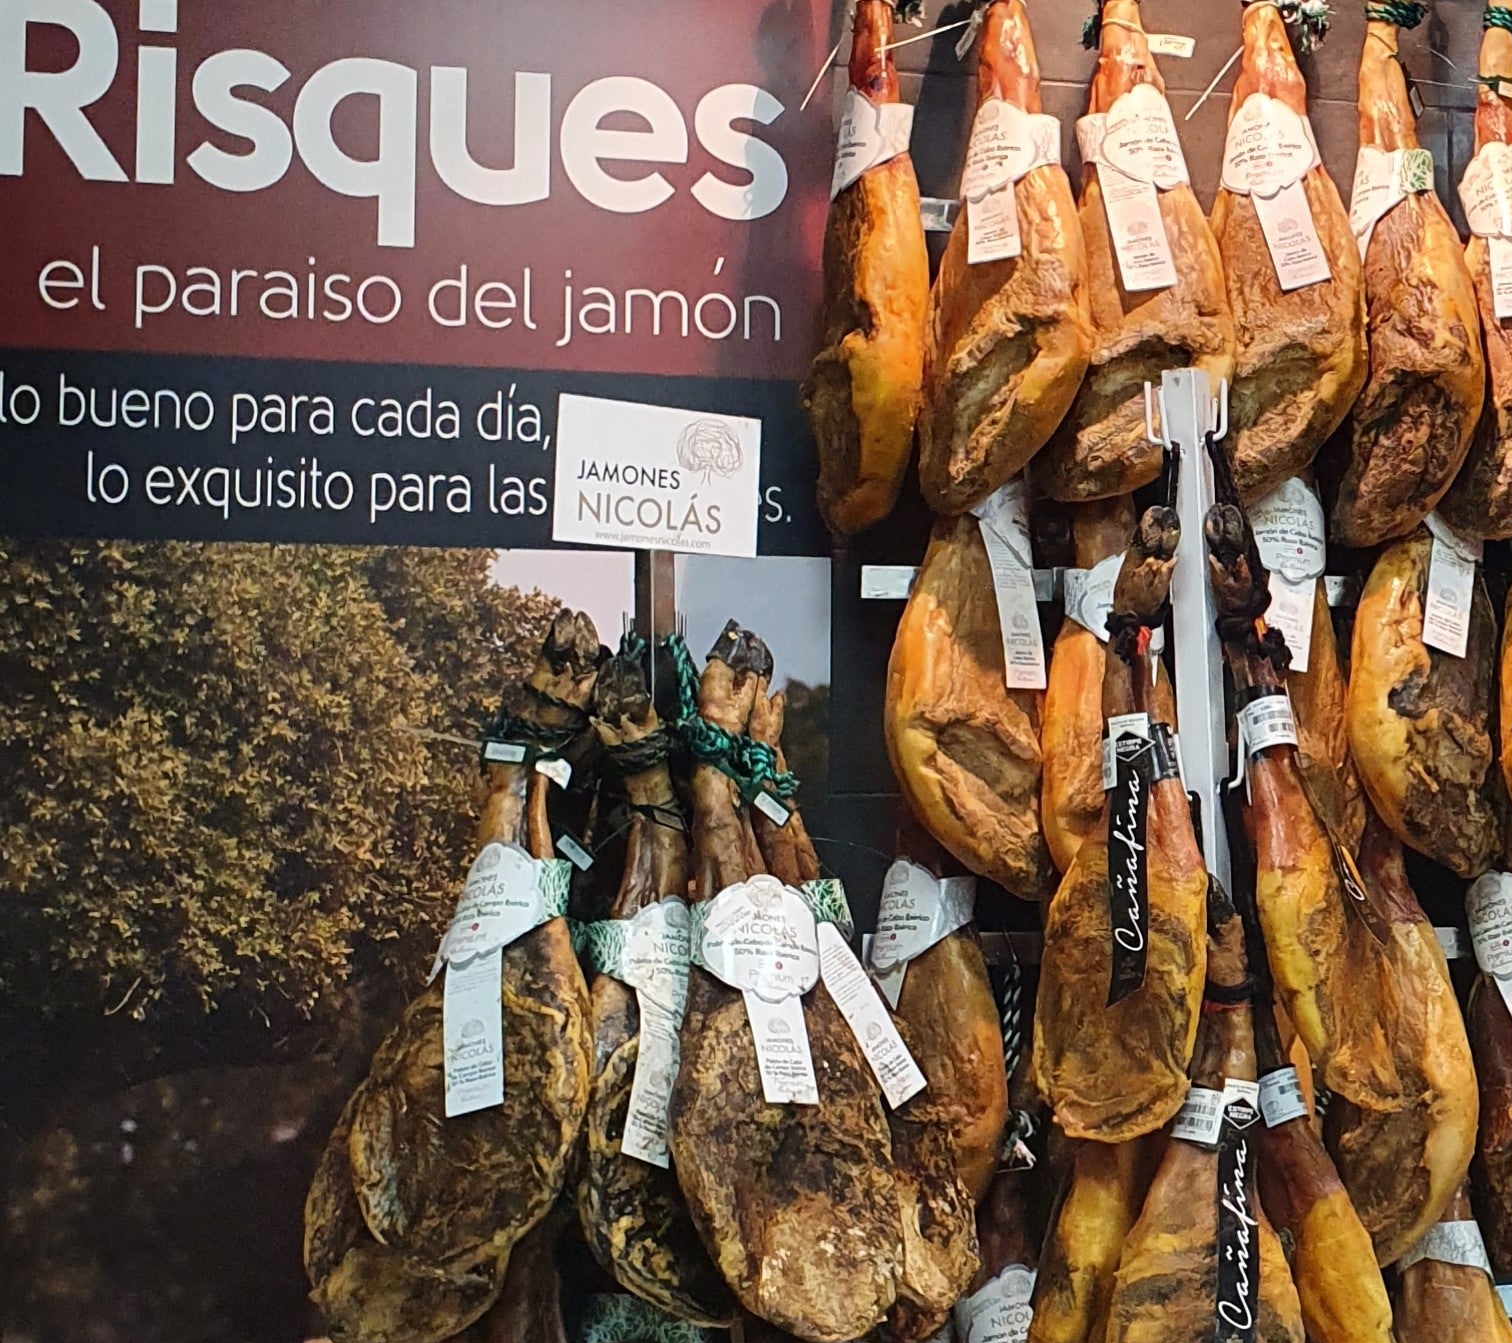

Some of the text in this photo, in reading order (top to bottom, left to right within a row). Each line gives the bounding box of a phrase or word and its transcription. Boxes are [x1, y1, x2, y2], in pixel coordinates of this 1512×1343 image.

[38, 247, 782, 346] el paraiso del jamón
[0, 372, 552, 450] lo bueno para cada día,
[87, 452, 548, 525] lo exquisito para las
[576, 460, 681, 490] JAMONES
[577, 492, 723, 535] NICOLÁS
[1113, 768, 1145, 952] Cañafina
[652, 942, 690, 957] NICO
[1218, 1138, 1259, 1331] Cañafina
